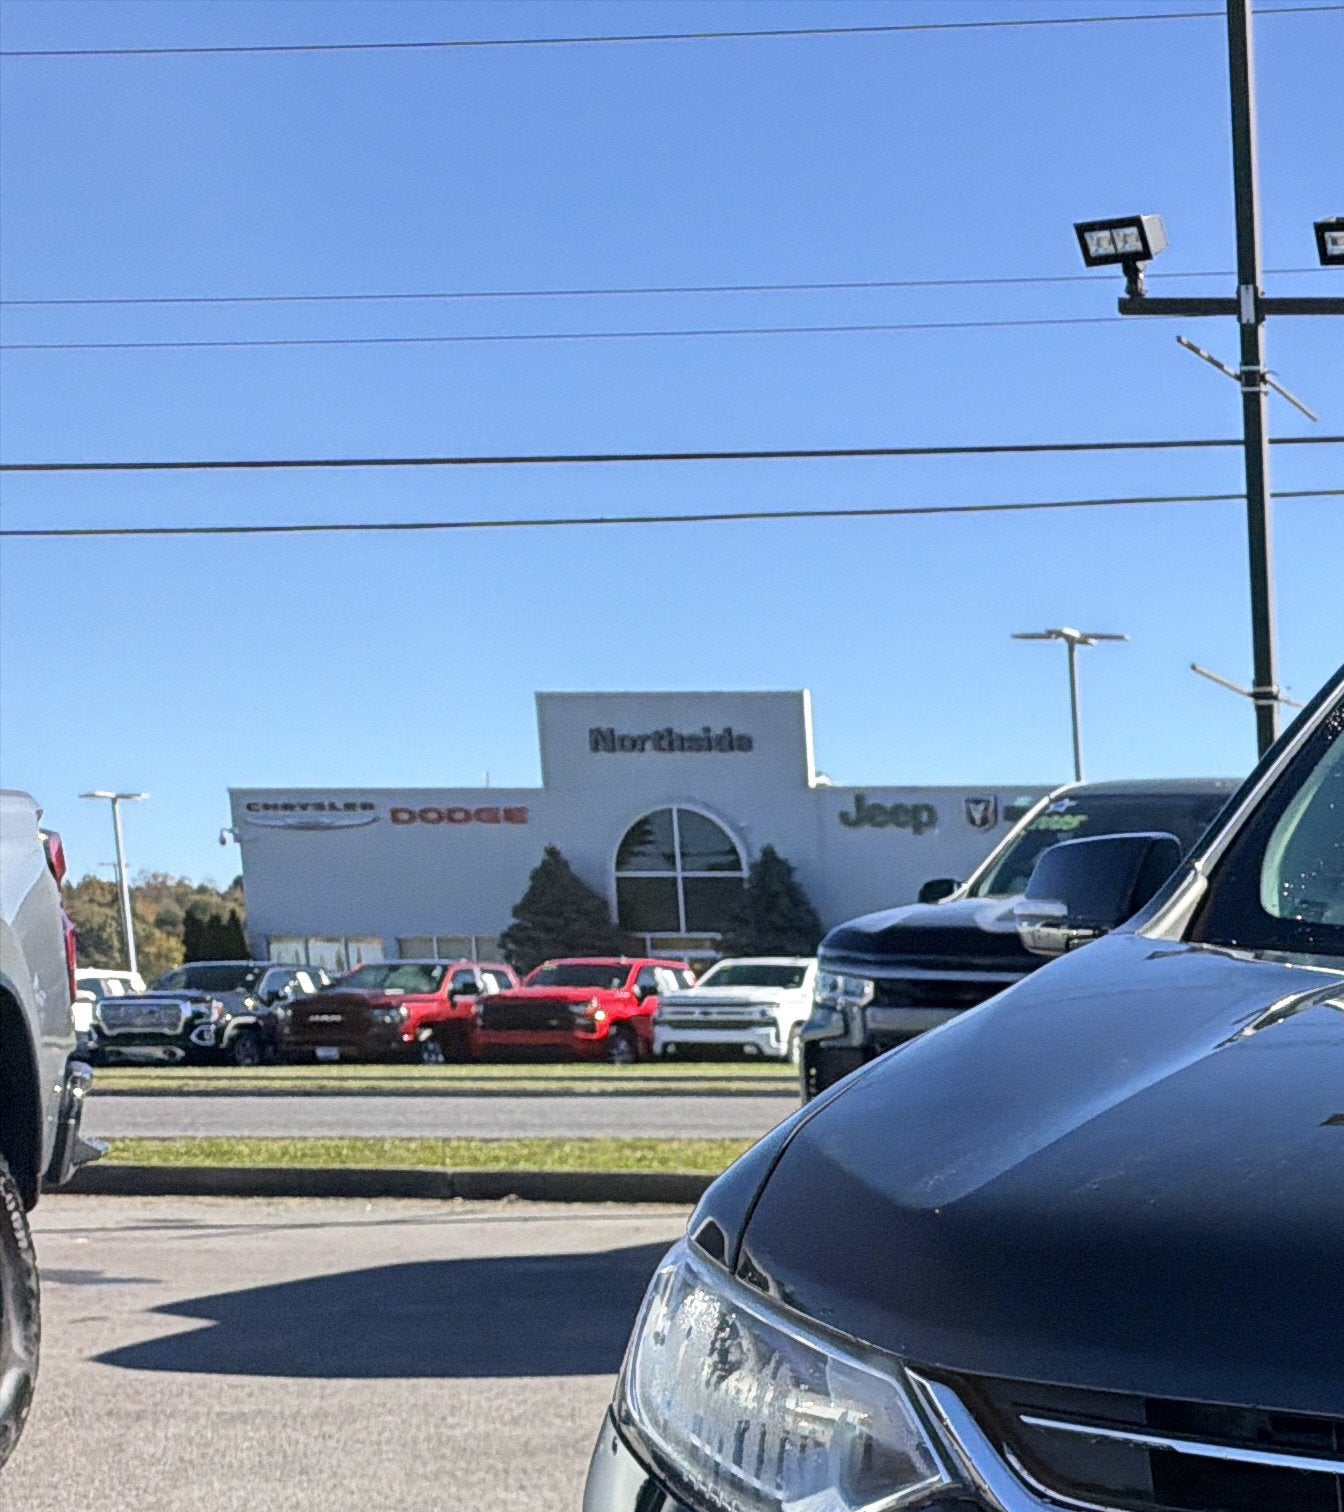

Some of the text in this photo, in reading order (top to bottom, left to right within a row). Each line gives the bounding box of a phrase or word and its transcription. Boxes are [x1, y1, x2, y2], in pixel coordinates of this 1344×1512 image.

[589, 727, 753, 753] Northside
[390, 807, 529, 824] DODGE
[839, 794, 937, 835] Jeep
